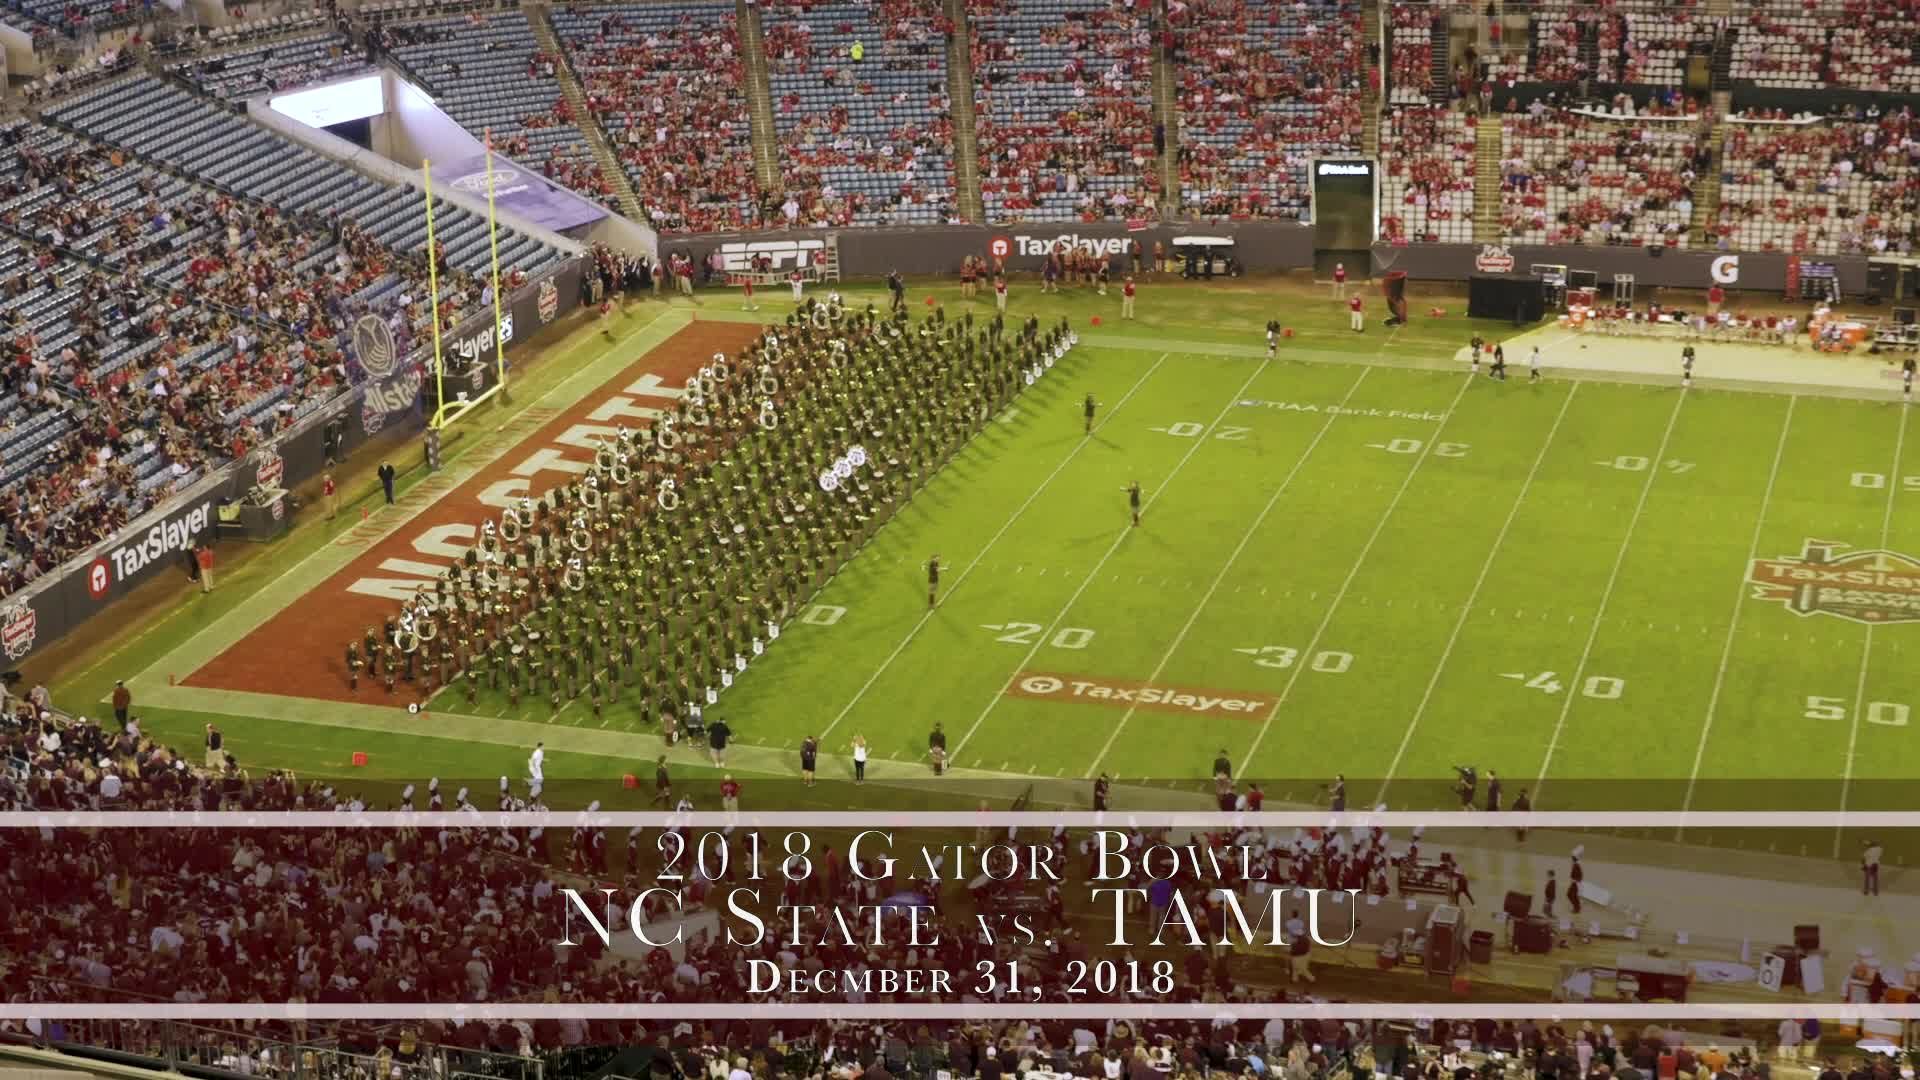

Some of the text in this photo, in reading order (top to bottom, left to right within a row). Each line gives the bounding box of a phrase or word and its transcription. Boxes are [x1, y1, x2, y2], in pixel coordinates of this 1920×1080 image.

[1014, 234, 1132, 258] TaxSlayer
[424, 325, 497, 375] TSlayer
[111, 502, 210, 582] TaxSlayer
[995, 622, 1096, 649] 20
[1253, 646, 1354, 673] 30
[1070, 681, 1266, 713] TaxSlayer
[1524, 671, 1625, 699] 40
[1804, 695, 1910, 726] 50
